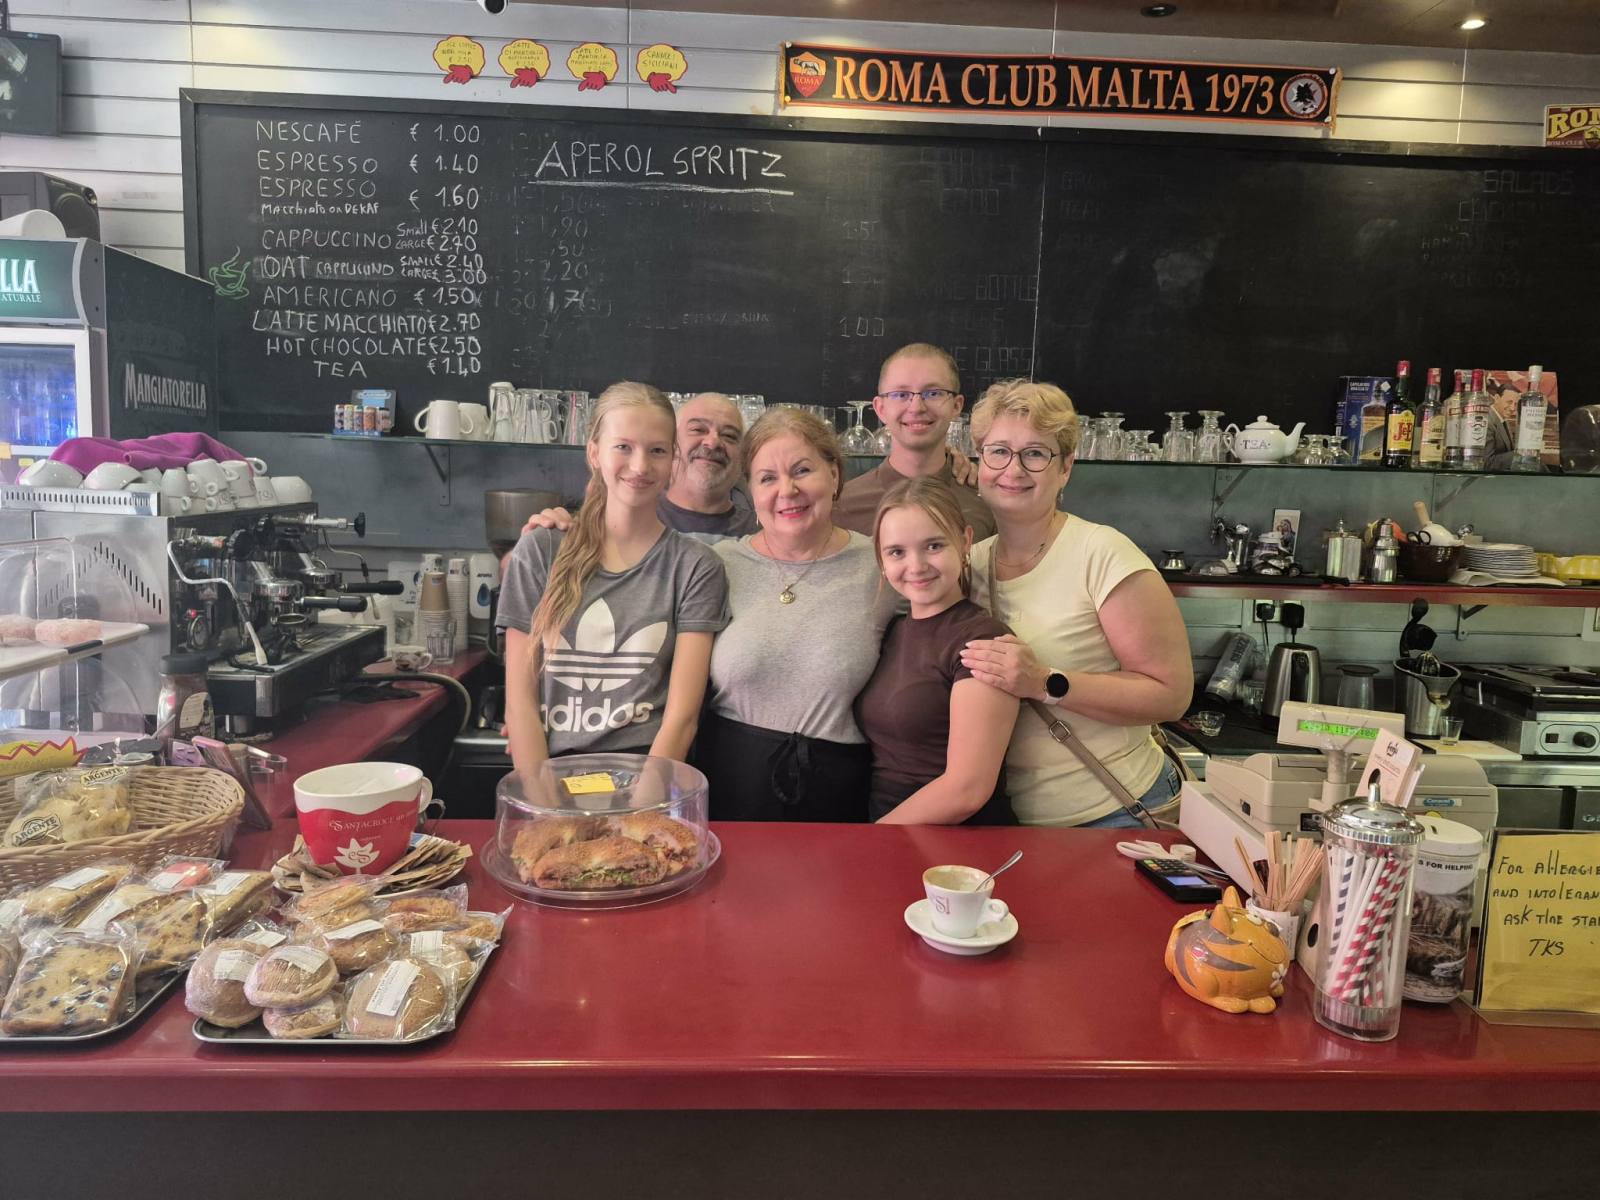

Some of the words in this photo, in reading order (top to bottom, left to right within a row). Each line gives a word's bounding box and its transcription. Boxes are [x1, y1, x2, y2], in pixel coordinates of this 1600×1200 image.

[833, 56, 950, 103] ROMA
[962, 62, 1057, 109] CLUB
[1067, 66, 1195, 113] MALTA
[1205, 73, 1275, 116] 1973
[256, 120, 361, 143] NESCAFÉ
[409, 123, 420, 142] €
[434, 124, 480, 143] 1.00
[257, 150, 378, 173] ESPRESSO
[409, 154, 419, 173] €
[435, 153, 479, 174] 1.40
[535, 141, 664, 177] APEROL
[673, 145, 786, 180] SPRITZ
[259, 176, 376, 198] ESPRESSO
[409, 189, 420, 210] €
[435, 184, 479, 210] 1.60
[262, 229, 392, 250] CAPPUCCINO
[0, 258, 41, 294] LLA
[263, 255, 309, 278] OAT
[263, 286, 397, 307] AMERICANO
[252, 310, 319, 333] LATTE
[324, 312, 426, 334] MACCHIATO
[267, 338, 305, 357] HOT
[311, 337, 426, 357] CHOCOLATE
[314, 360, 367, 379] TEA
[1426, 861, 1443, 870] FOR
[1493, 888, 1519, 899] AND
[1504, 904, 1533, 926] ASK
[1528, 938, 1565, 956] TKS
